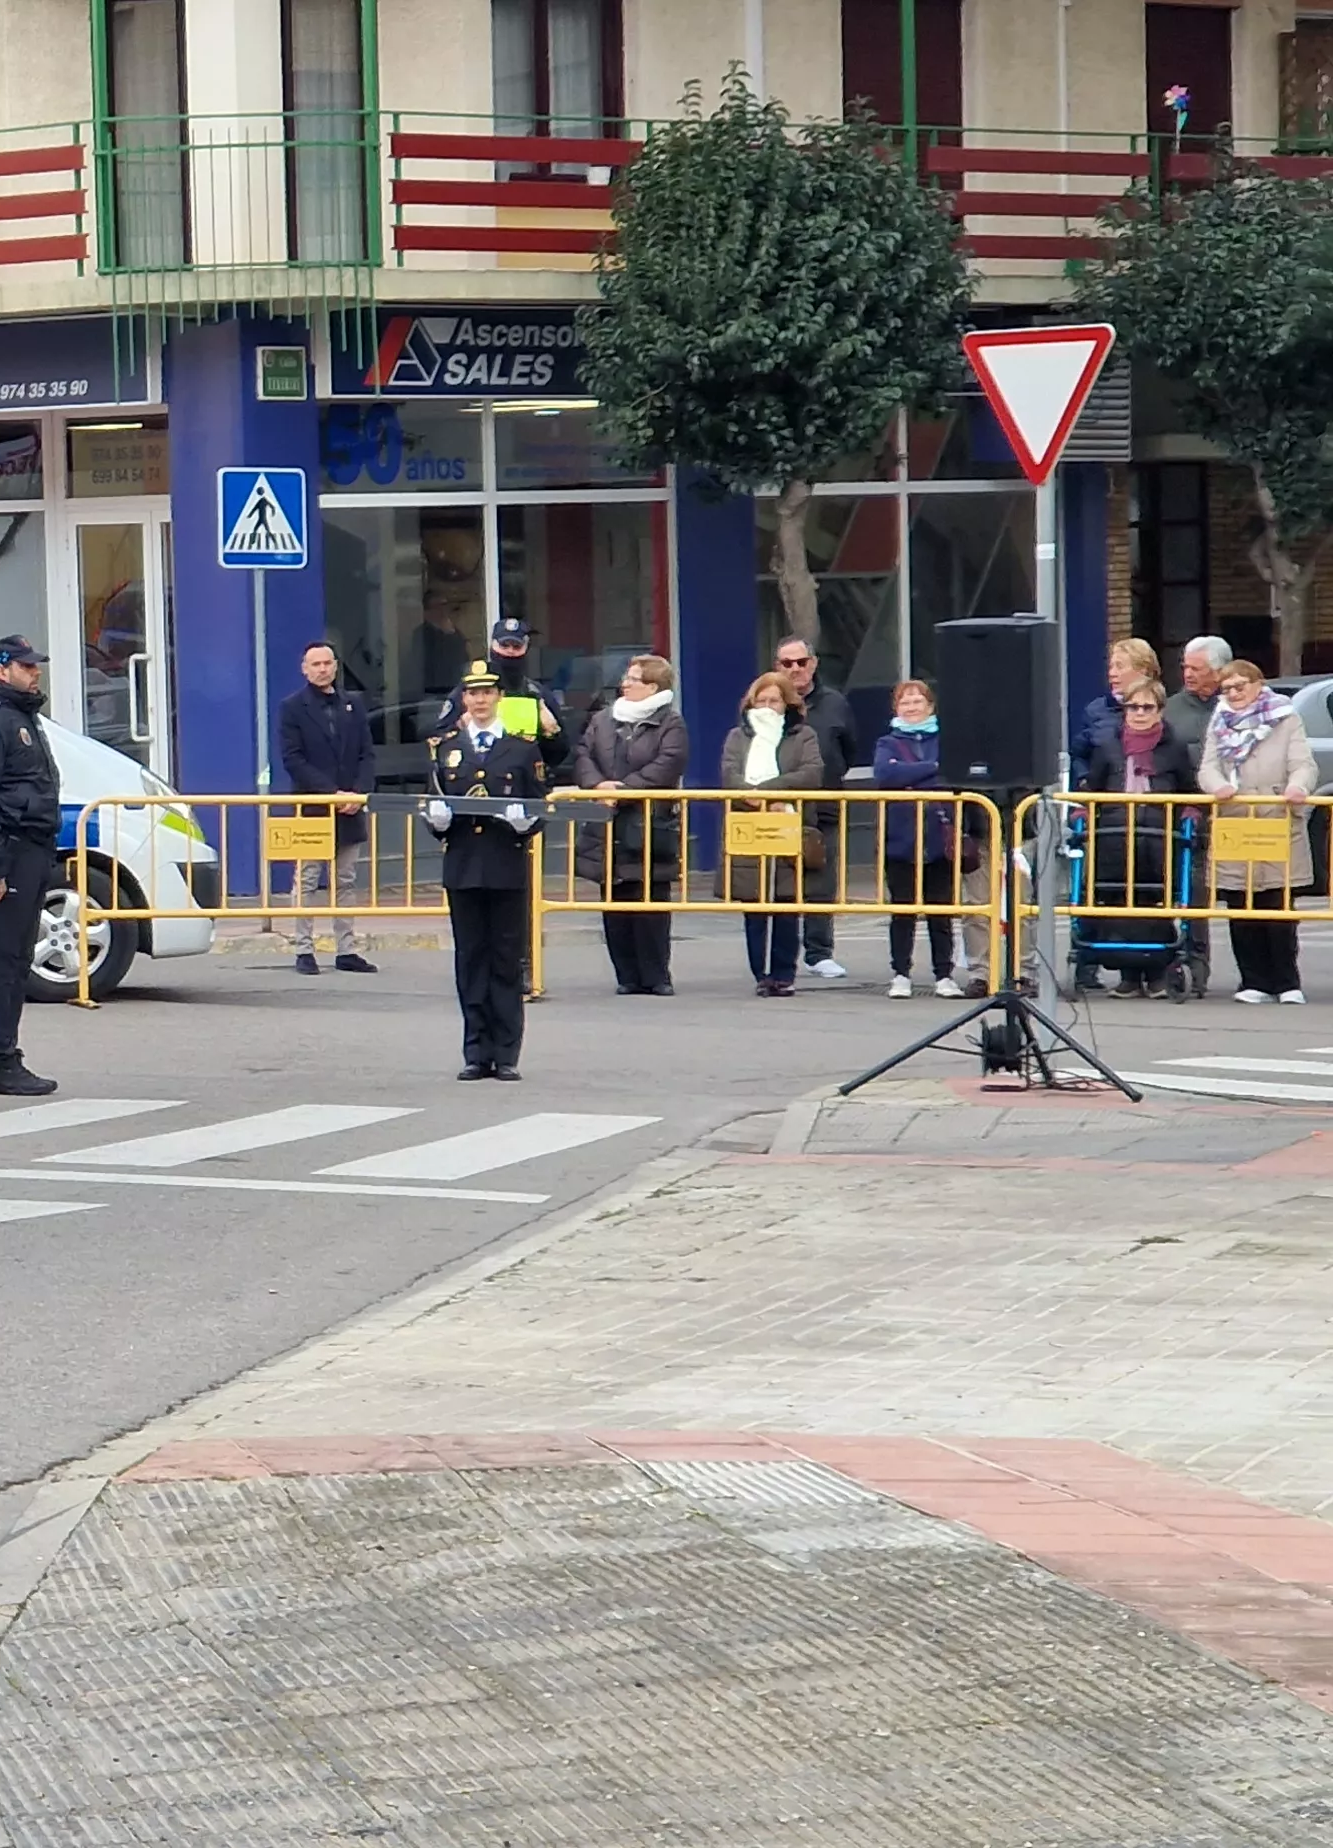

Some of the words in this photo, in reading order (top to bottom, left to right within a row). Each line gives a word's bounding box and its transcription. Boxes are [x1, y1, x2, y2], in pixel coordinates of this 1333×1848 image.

[444, 353, 555, 385] SALES
[0, 383, 26, 400] 974
[29, 382, 47, 398] 35
[49, 381, 67, 397] 35
[70, 379, 89, 395] 90
[406, 450, 466, 481] años
